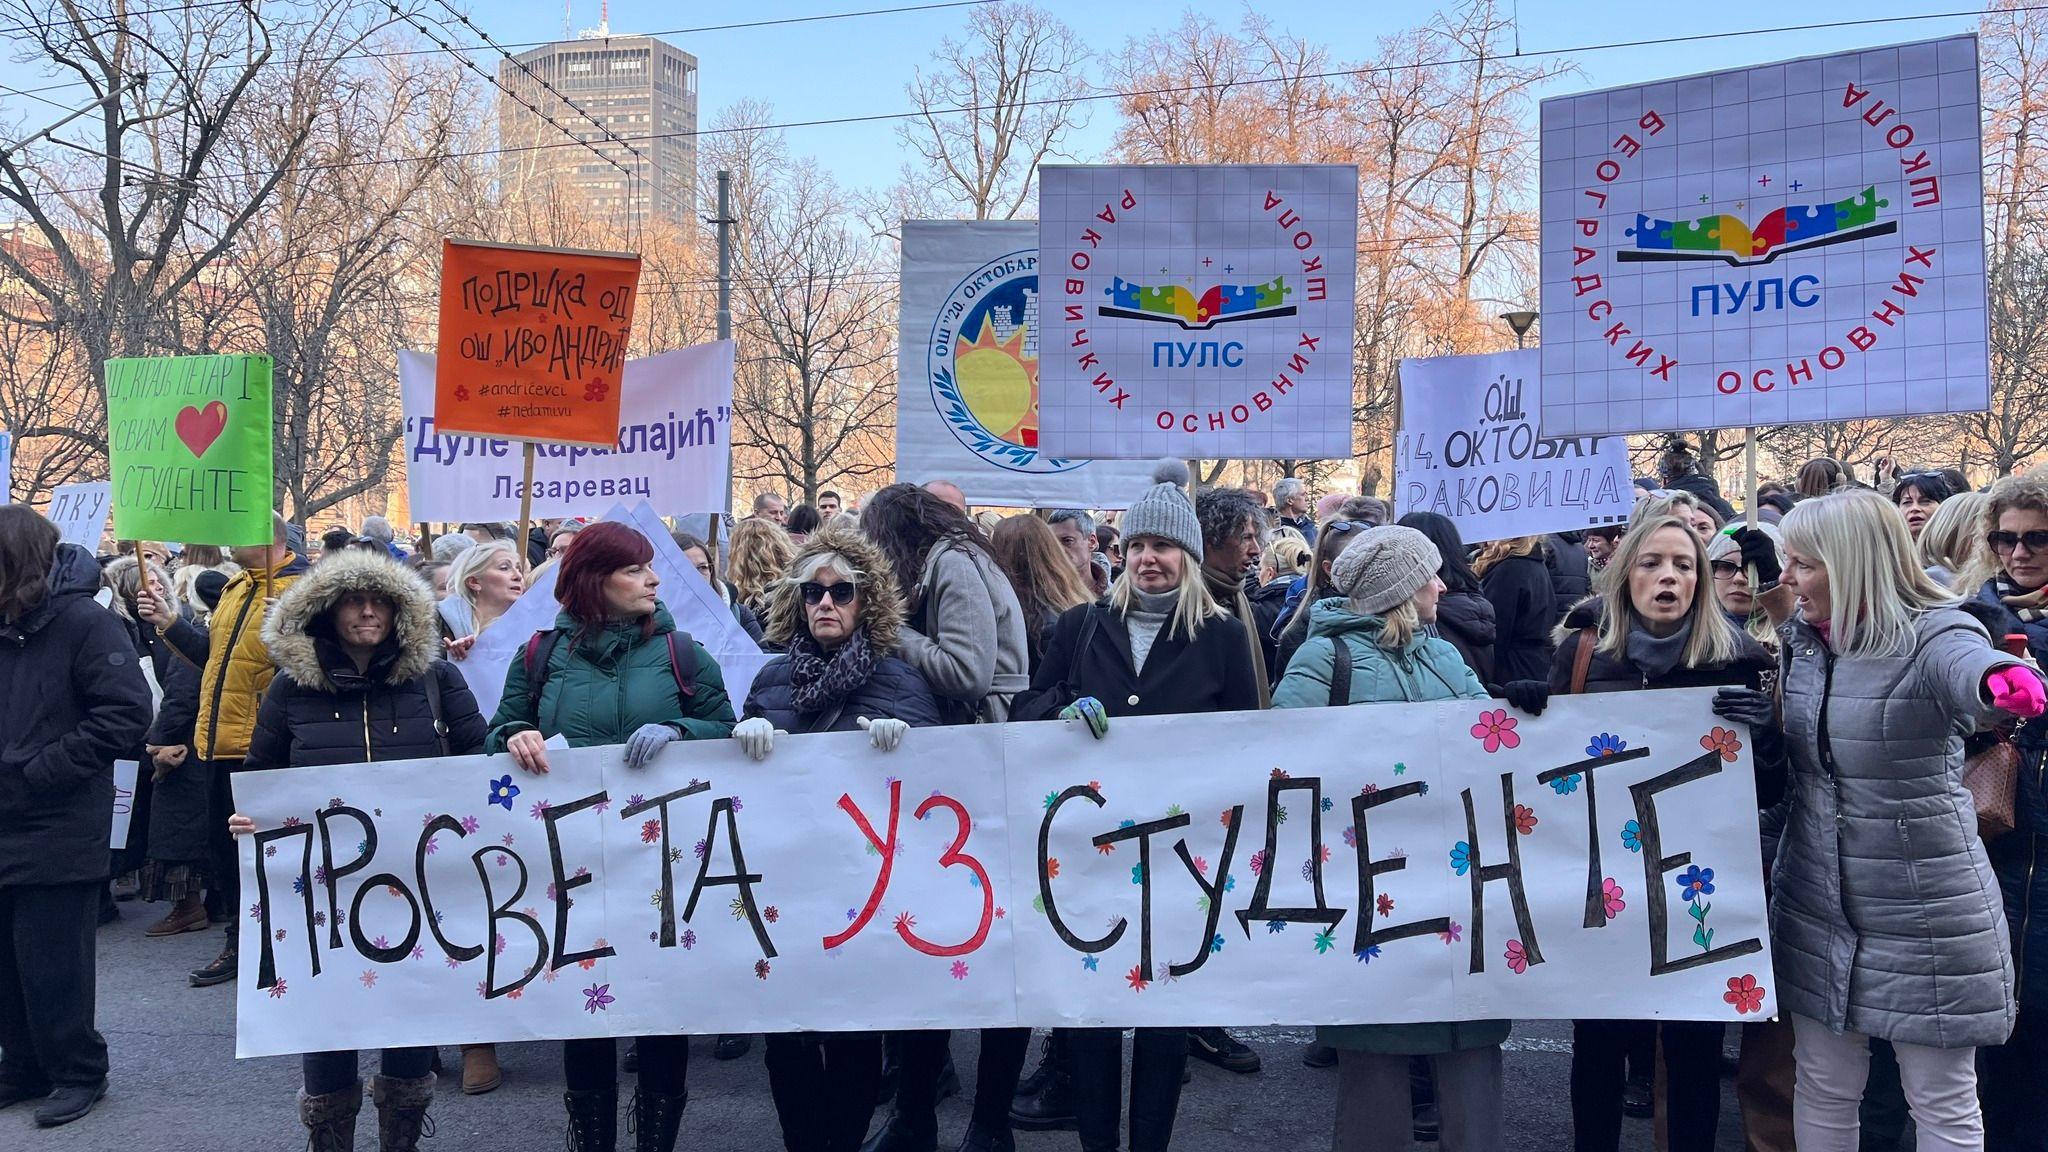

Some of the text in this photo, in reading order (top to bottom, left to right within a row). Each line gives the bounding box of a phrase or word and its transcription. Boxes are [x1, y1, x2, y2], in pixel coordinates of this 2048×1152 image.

[1571, 82, 1941, 395] БЕОГРАДСКИХ ОСНОВНИХ ШКОЛА
[1065, 189, 1327, 432] РАКОВИЧКИХ ОСНОВНИХ ШКОЛА
[1692, 275, 1821, 317] ПУЛС
[935, 328, 951, 357] ОШ
[1152, 342, 1244, 368] ПУЛС
[115, 416, 168, 452] СВИМ
[119, 465, 249, 516] СТУДЕНТЕ
[492, 475, 650, 503] Лазаревац
[1408, 467, 1620, 517] РАКОВИЦА
[822, 780, 994, 957] УЗ
[1038, 746, 1764, 982] СТУДЕНТЕ
